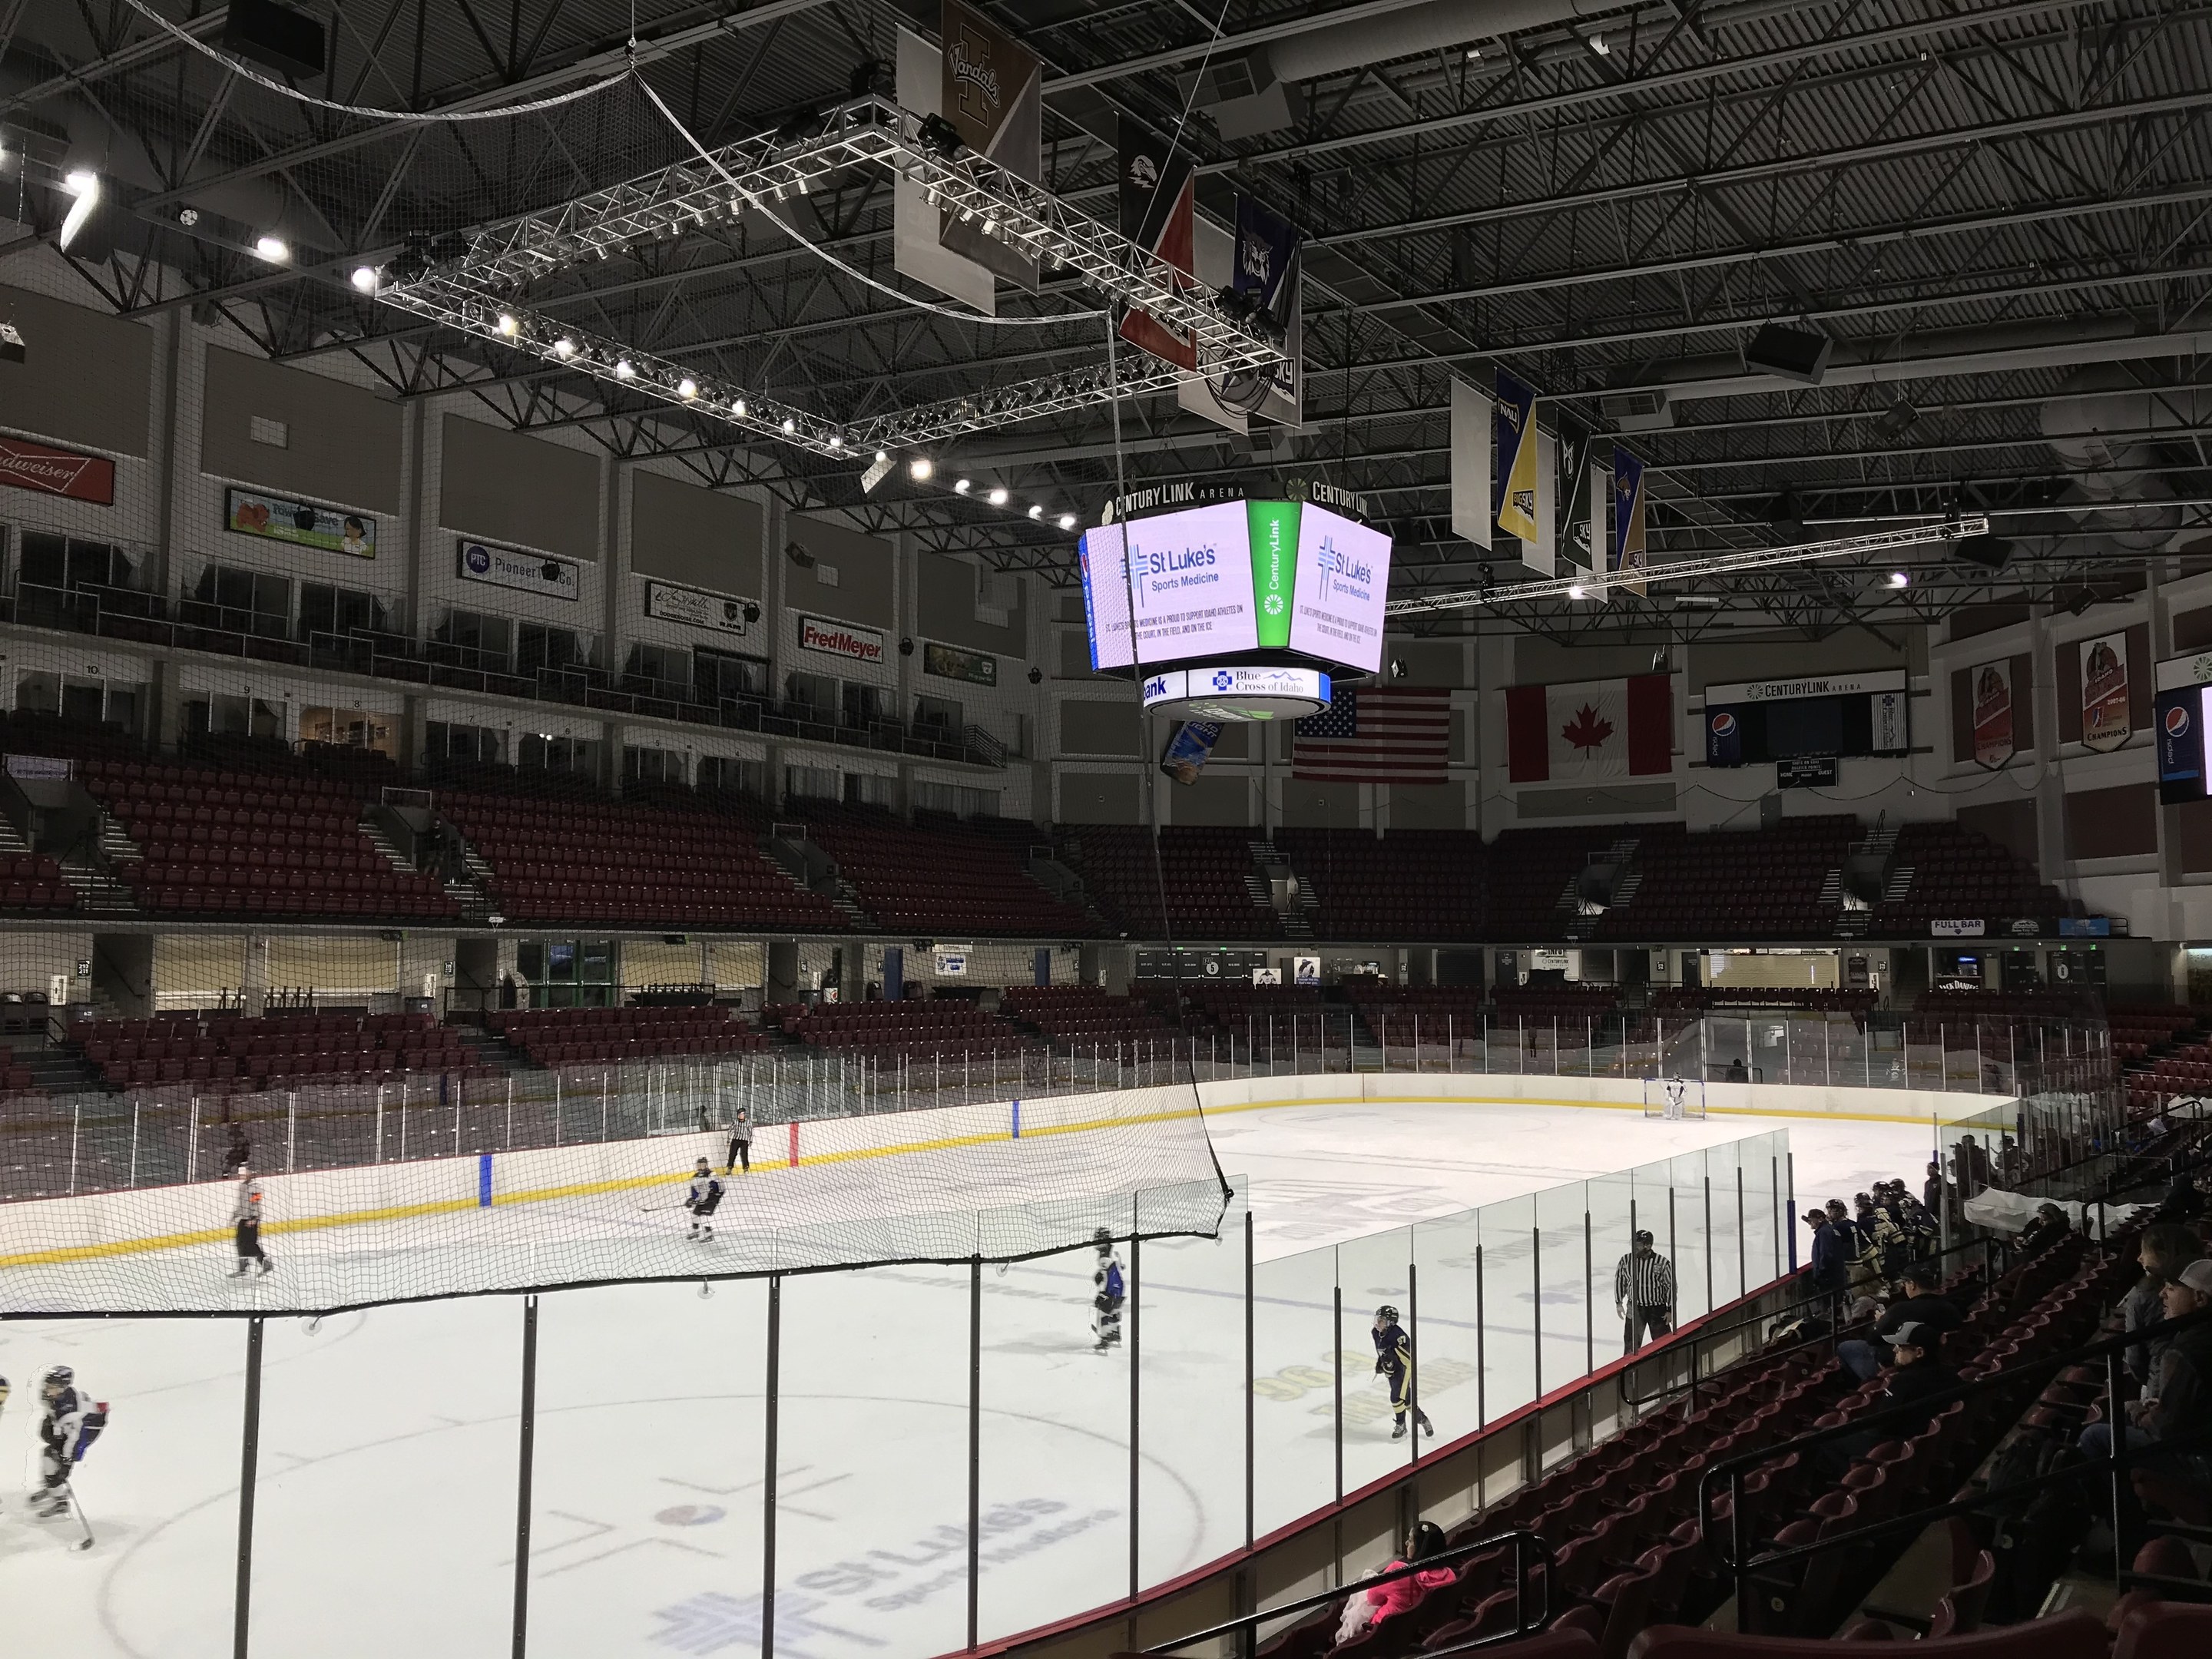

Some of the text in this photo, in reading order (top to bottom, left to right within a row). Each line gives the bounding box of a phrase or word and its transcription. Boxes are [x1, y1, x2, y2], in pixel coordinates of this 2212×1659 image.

[948, 45, 998, 98] Vandals
[1500, 403, 1518, 423] NAU
[1116, 482, 1244, 516] CNTURYLINK ARENA
[471, 553, 486, 567] PTC
[1150, 544, 1216, 575] St Luke's
[1269, 519, 1282, 591] CenturyLink
[495, 558, 536, 578] Pioneer
[1335, 552, 1372, 584] St Luke's
[1151, 572, 1220, 594] Sports Medicine
[1333, 579, 1371, 601] Sports Medicine
[1139, 616, 1158, 627] MEDICINE
[1158, 616, 1163, 624] IS
[1164, 615, 1167, 624] A
[1167, 613, 1181, 623] PROUD
[1181, 613, 1185, 621] TO
[1186, 609, 1204, 621] SUPPORT
[1204, 608, 1217, 618] IDAHO
[1217, 605, 1237, 616] ATHLETES
[1237, 604, 1243, 614] ON
[719, 621, 741, 631] RAM
[1157, 629, 1161, 637] IN
[1182, 624, 1190, 634] AND
[1190, 624, 1197, 633] ON
[1197, 622, 1205, 631] THE
[86, 665, 99, 674] 10
[1236, 671, 1261, 681] Blue
[244, 686, 250, 694] 9
[1236, 681, 1304, 694] Cross of Idaho
[1765, 681, 1862, 697] CENTURYLINK ARENA
[354, 700, 360, 708] 8
[2087, 727, 2127, 742] CHAMPIONS
[1977, 737, 2012, 751] CHAMPIONS
[2167, 737, 2175, 765] pepsi
[1934, 920, 1982, 929] FULL BAR
[1210, 964, 1215, 972] 5
[1396, 1335, 1406, 1346] 97
